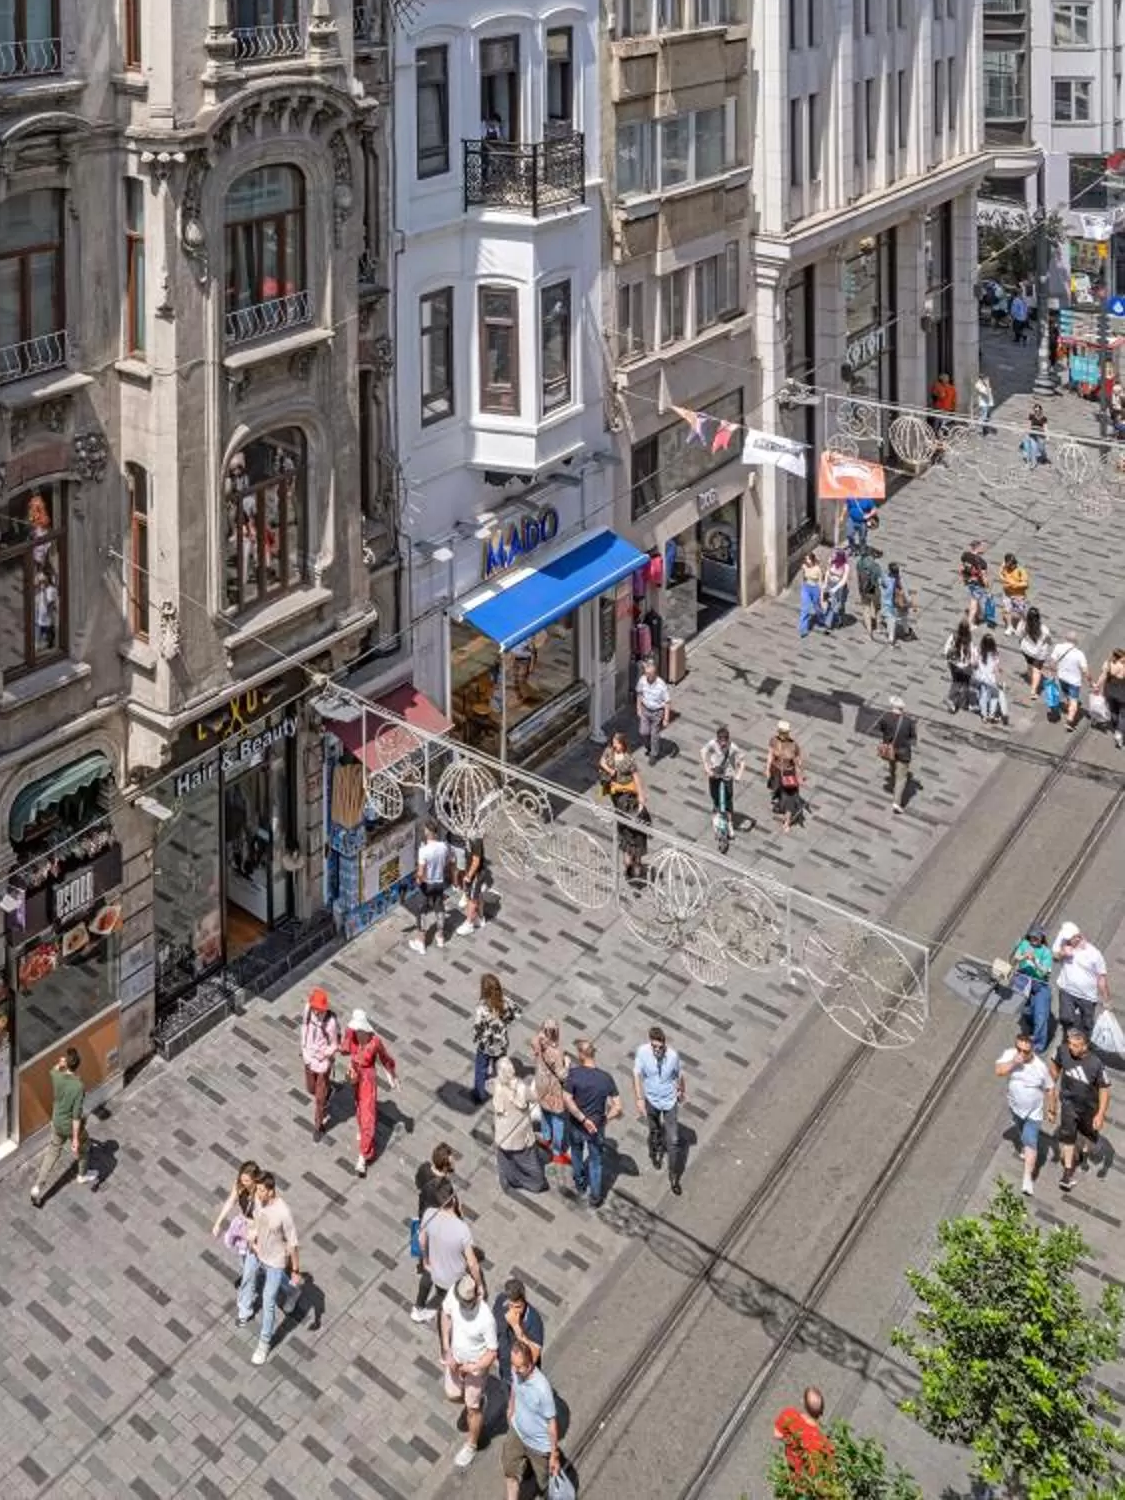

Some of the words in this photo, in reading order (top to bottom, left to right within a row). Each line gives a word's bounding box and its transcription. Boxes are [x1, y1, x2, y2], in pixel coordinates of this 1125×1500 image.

[481, 506, 559, 579] MADO
[176, 761, 215, 797] Hair
[221, 750, 233, 773] &
[240, 716, 298, 761] Beauty
